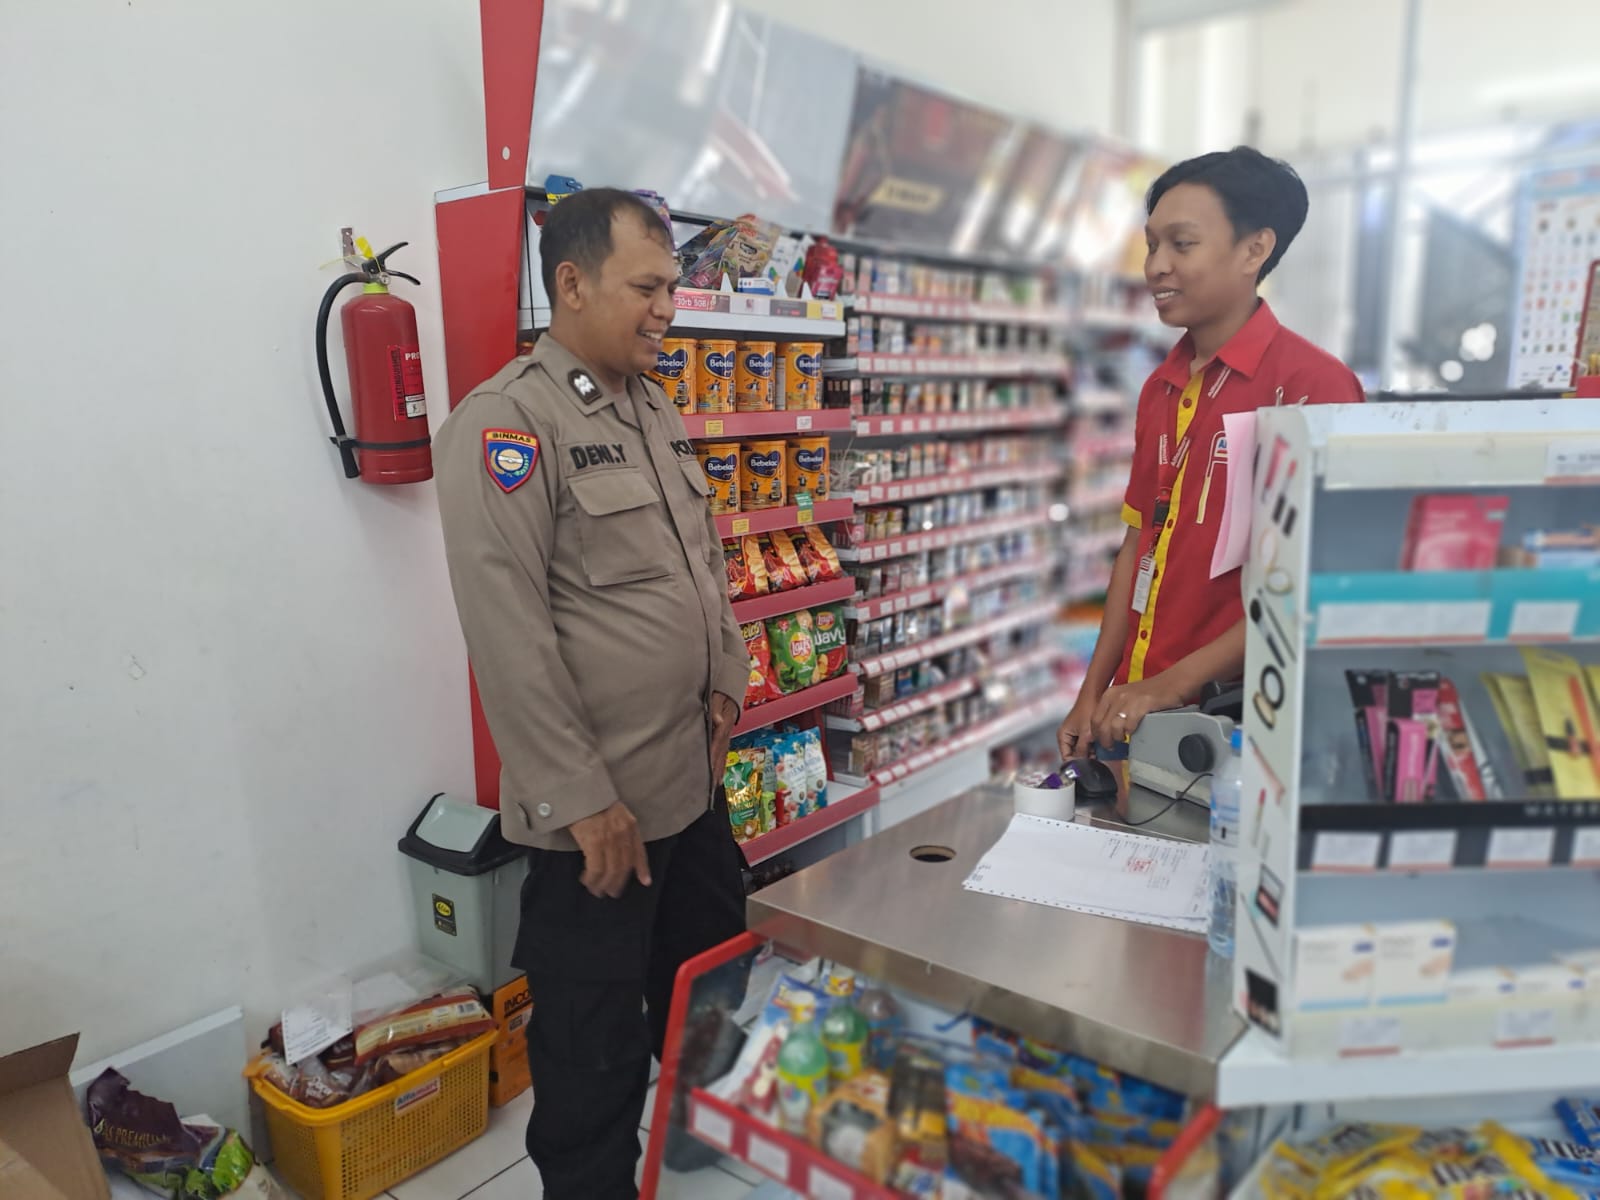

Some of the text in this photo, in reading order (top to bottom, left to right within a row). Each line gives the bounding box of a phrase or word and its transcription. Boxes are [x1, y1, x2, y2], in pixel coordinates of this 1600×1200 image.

[657, 357, 685, 368] ebelac
[491, 431, 533, 444] BINMAS
[707, 462, 736, 472] Bebelac
[750, 458, 779, 468] Bebelac
[397, 1080, 438, 1106] Alfamart
